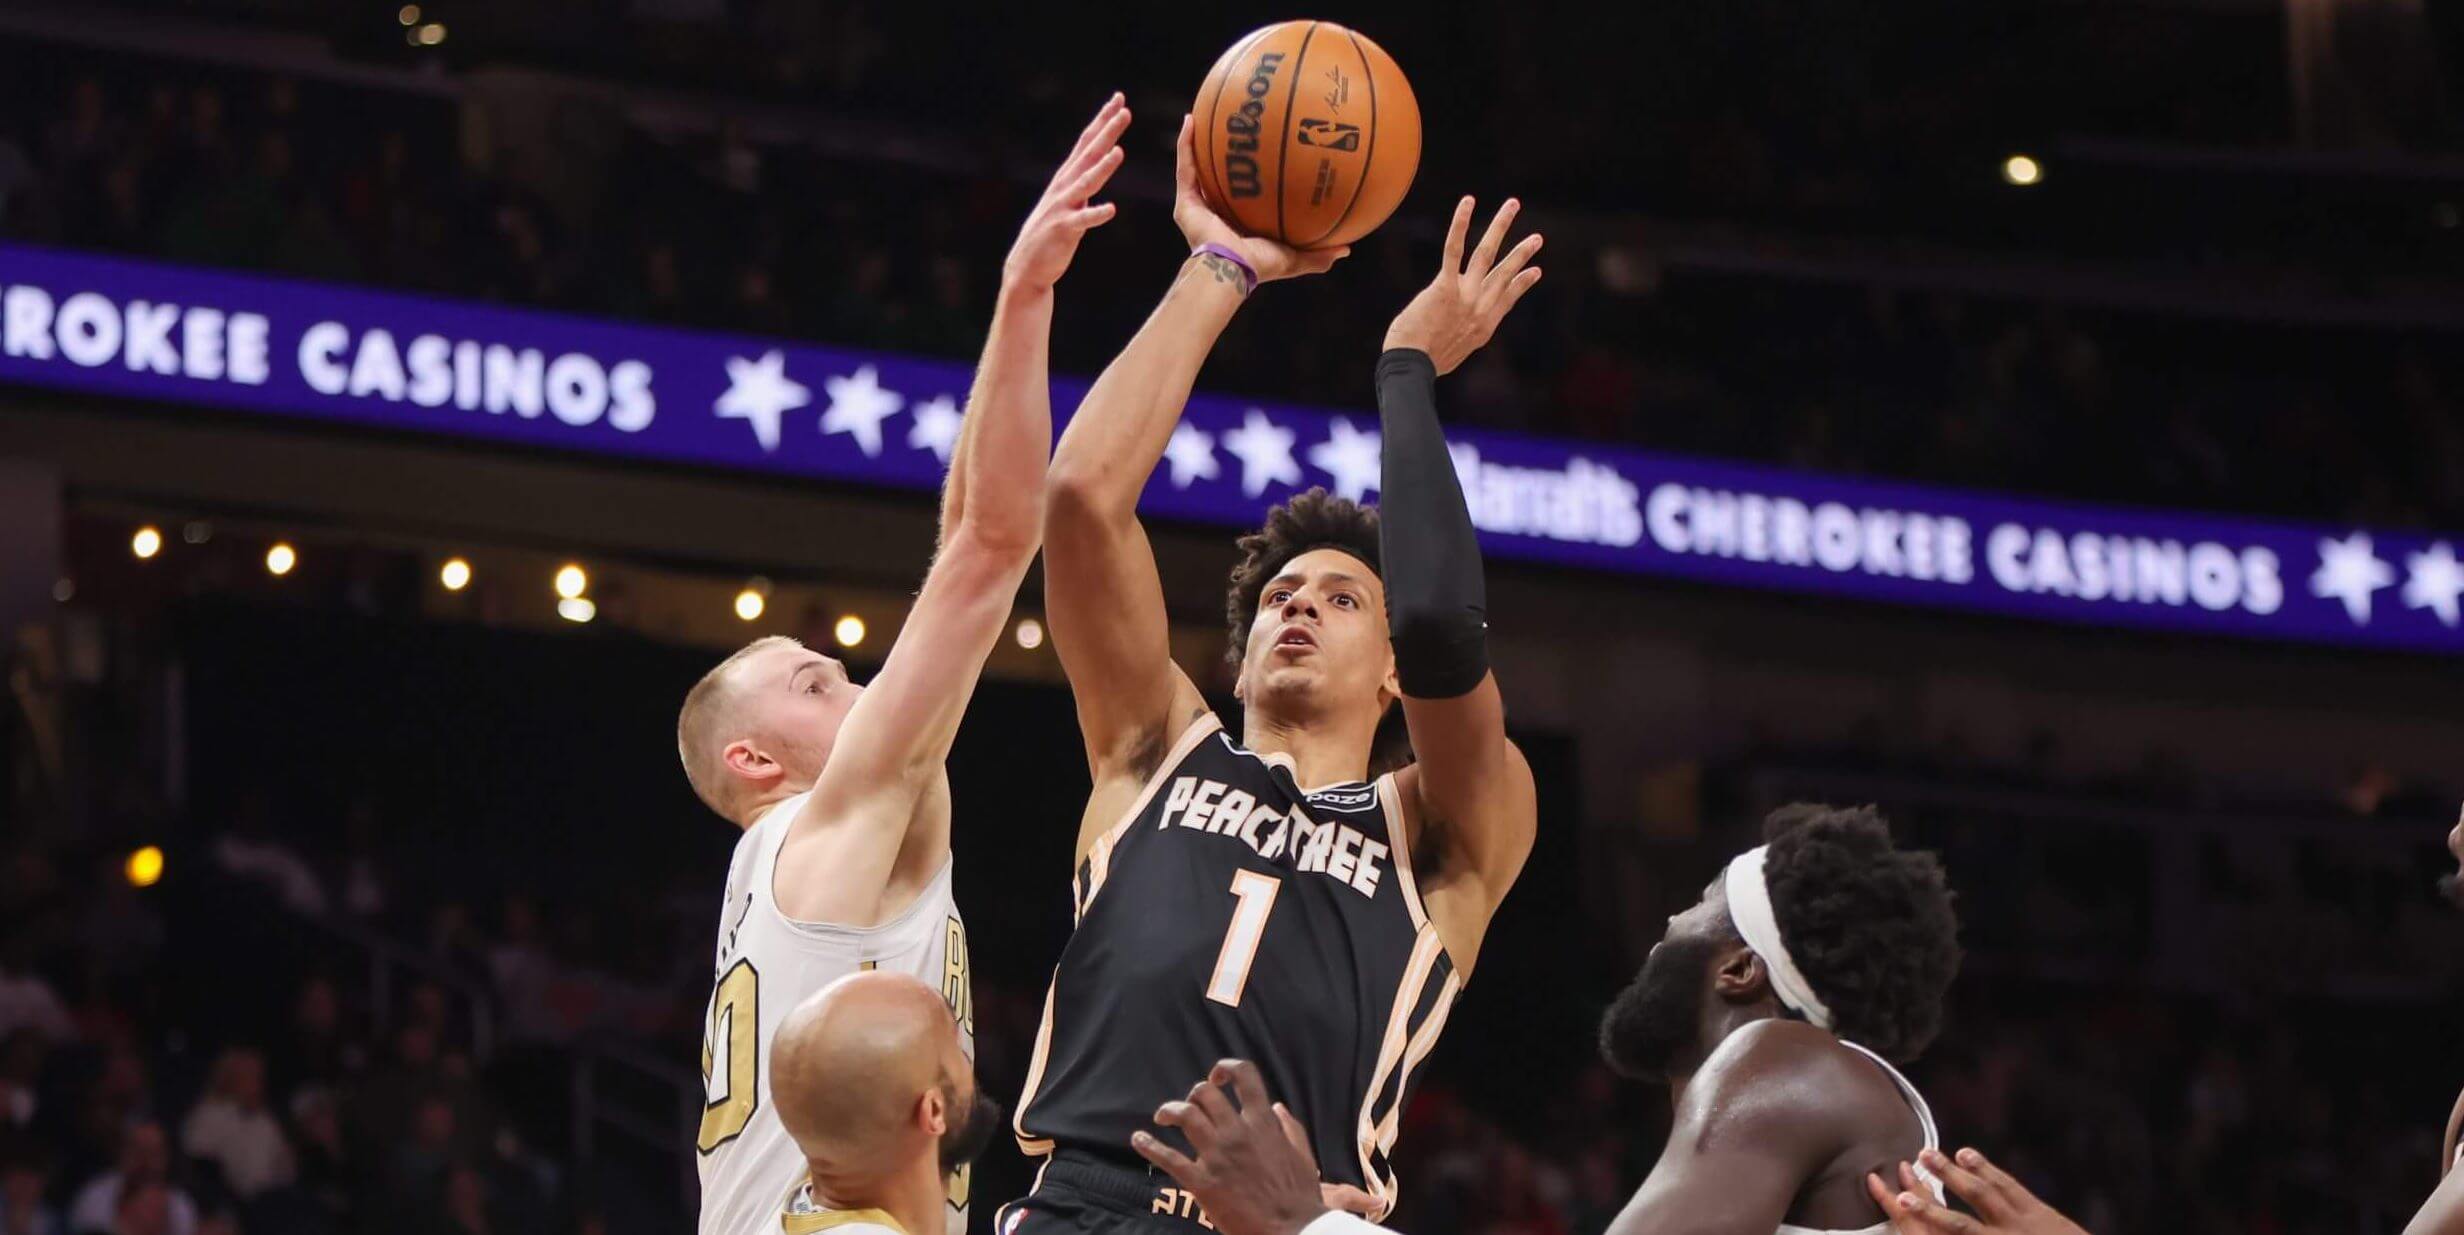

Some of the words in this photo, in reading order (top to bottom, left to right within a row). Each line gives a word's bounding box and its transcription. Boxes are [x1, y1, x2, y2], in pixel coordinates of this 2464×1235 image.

[1226, 52, 1285, 199] Wilson
[0, 284, 270, 386] ROKEE
[298, 321, 657, 432] CASINOS
[1645, 482, 1975, 585] CHEROKEE
[1986, 523, 2284, 615] CASINOS
[1158, 776, 1388, 899] PEACHTREE
[1306, 792, 1370, 804] paze
[1206, 868, 1281, 1007] 1
